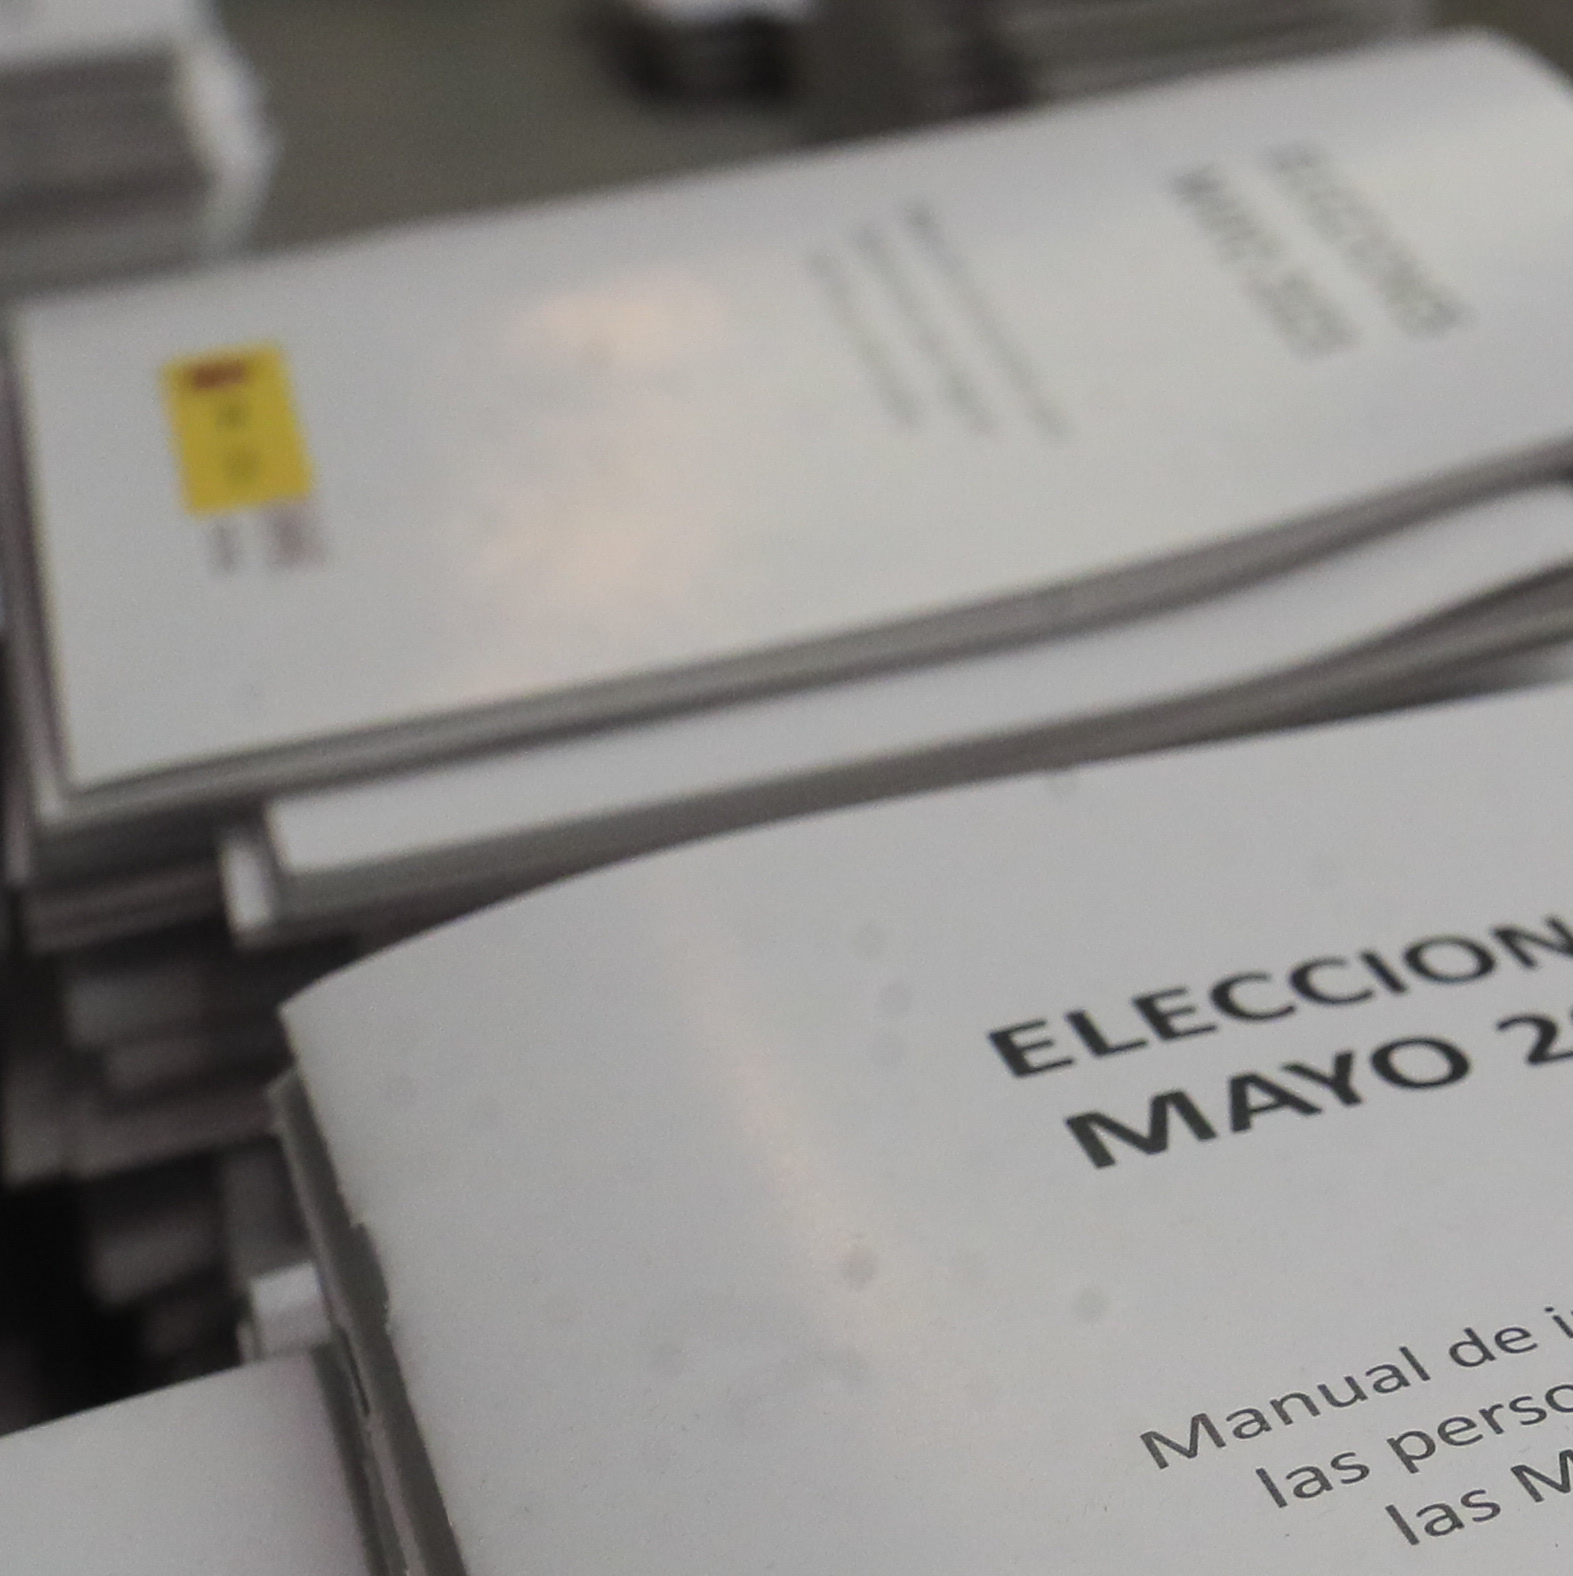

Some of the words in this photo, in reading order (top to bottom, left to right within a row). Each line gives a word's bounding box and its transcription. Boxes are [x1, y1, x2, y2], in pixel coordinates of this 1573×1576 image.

[1063, 1033, 1473, 1172] MAYO
[1138, 1345, 1432, 1471] Manual
[1447, 1325, 1540, 1369] de
[1254, 1450, 1372, 1510] las
[1384, 1488, 1503, 1547] las
